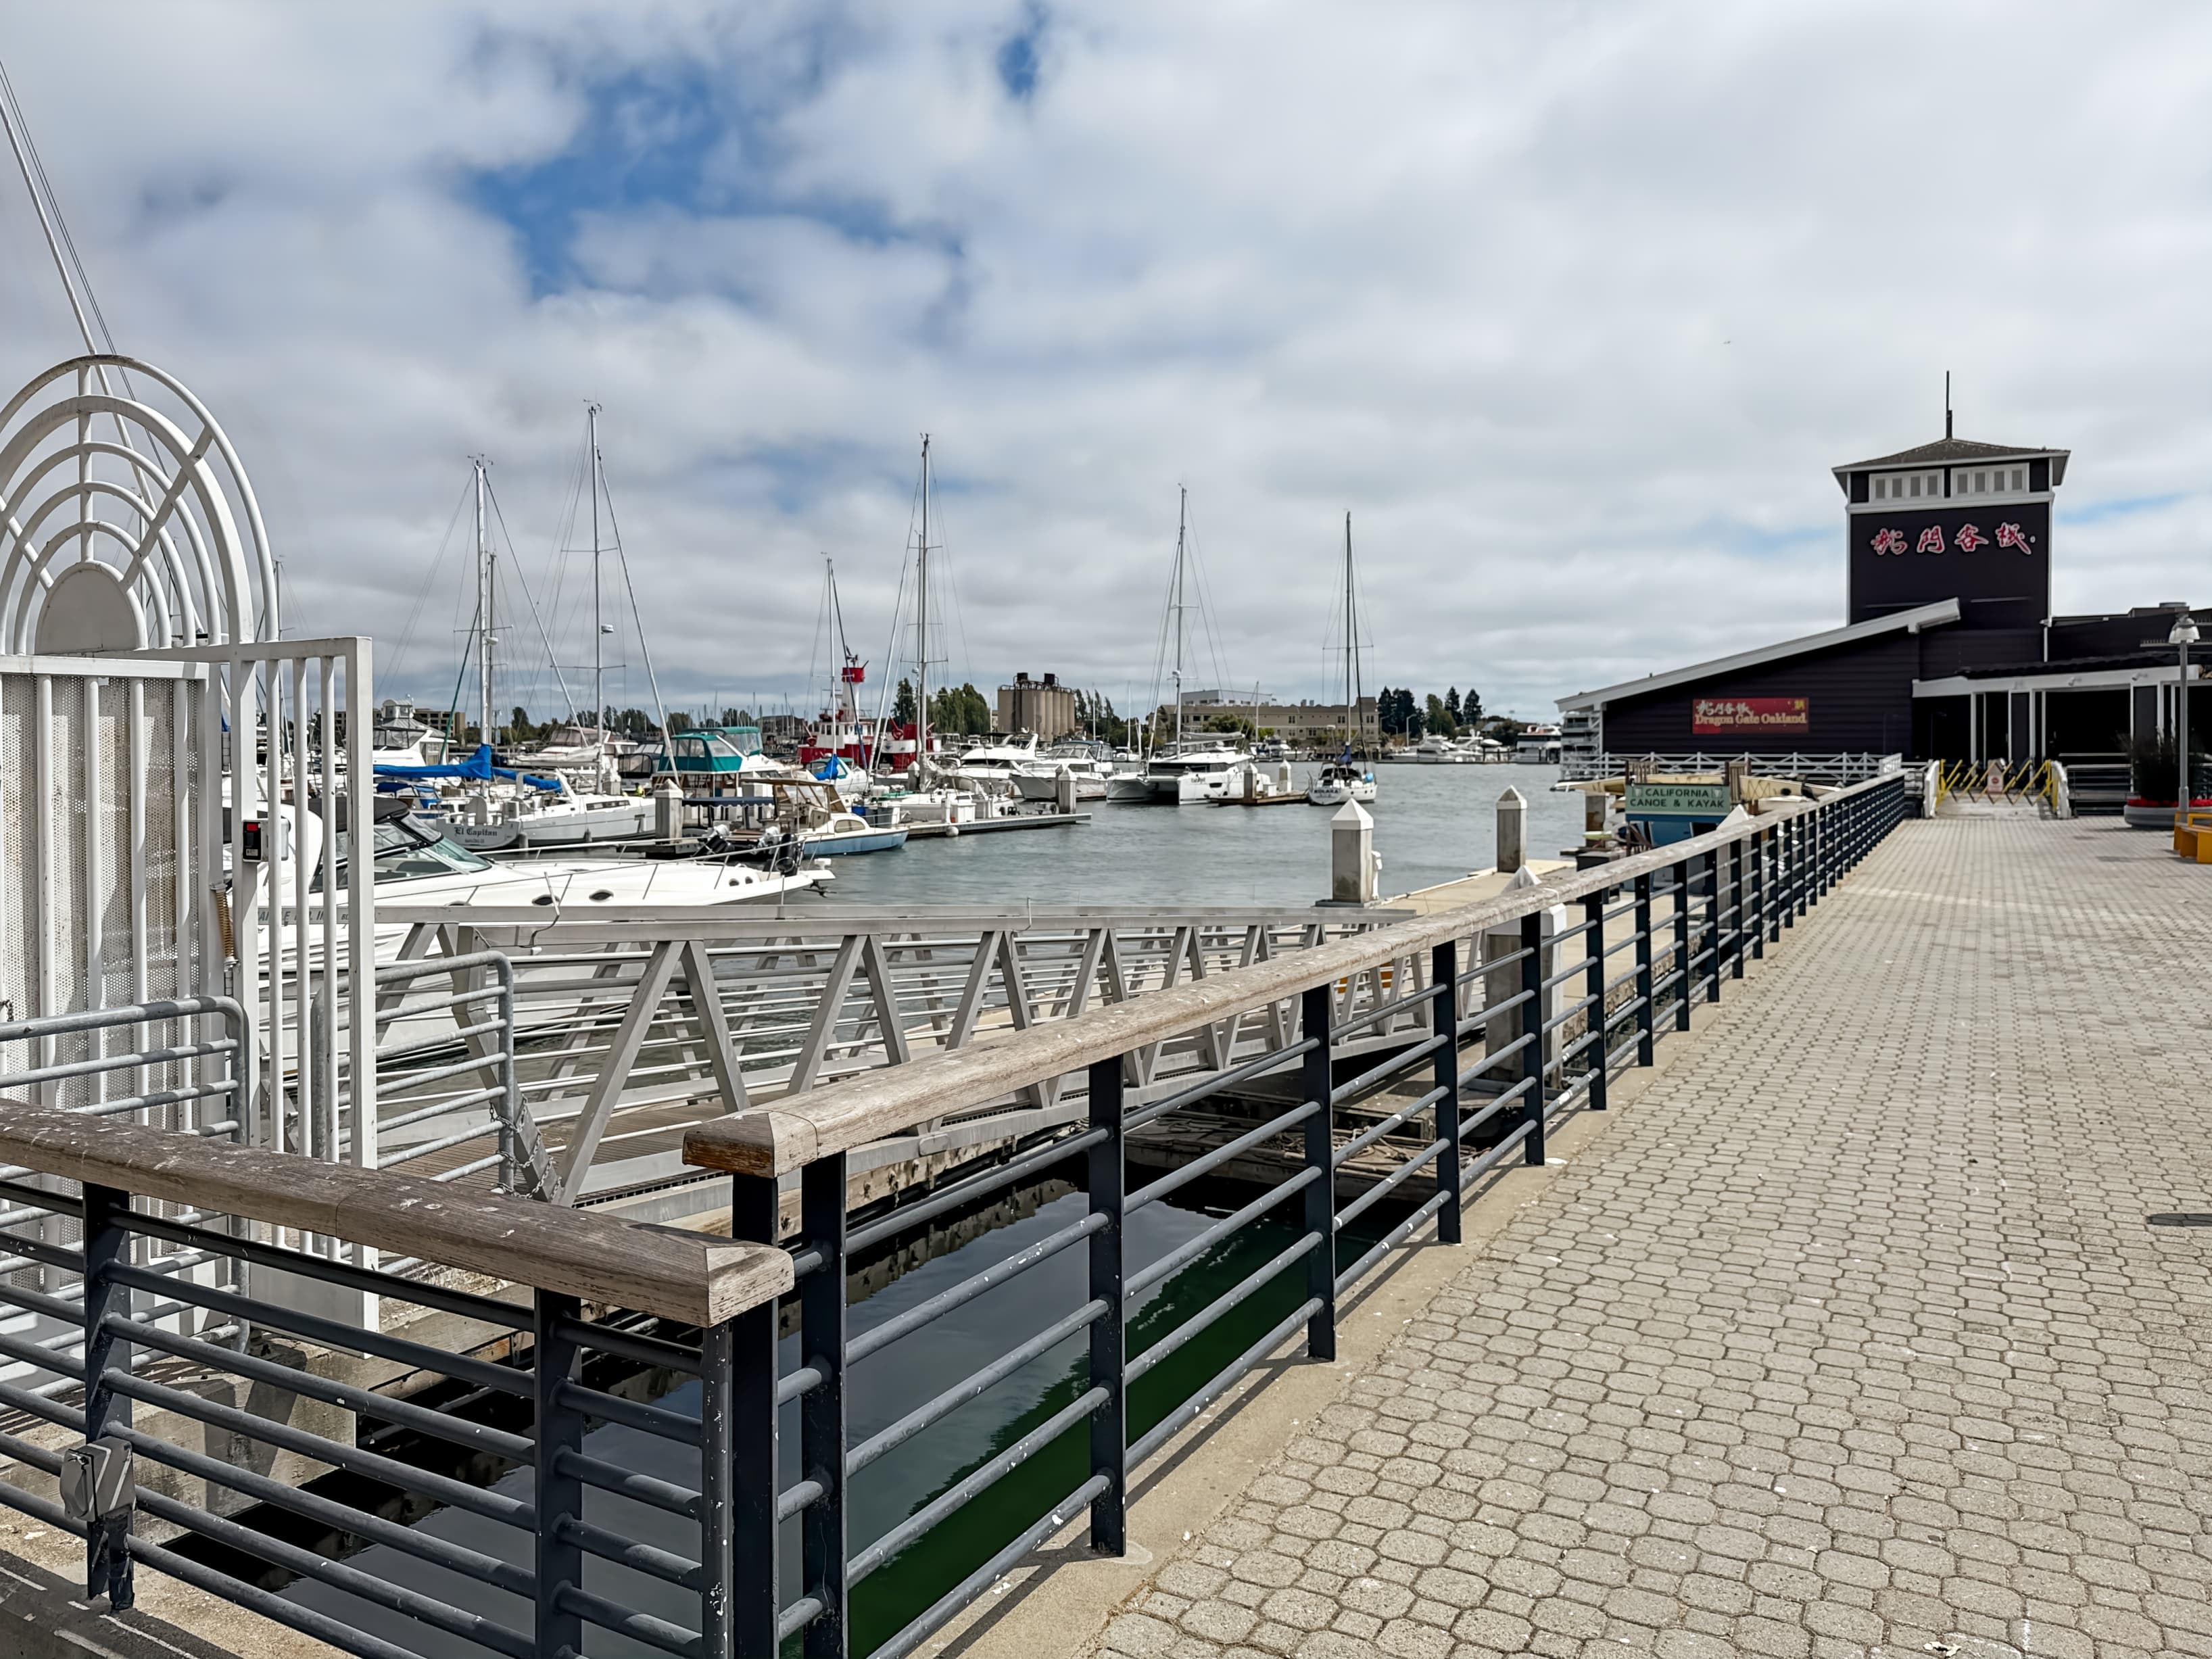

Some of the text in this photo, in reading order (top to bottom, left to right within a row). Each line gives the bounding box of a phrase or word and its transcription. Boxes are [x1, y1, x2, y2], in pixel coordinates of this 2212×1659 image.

[1695, 714, 1733, 726] Dragon
[1735, 714, 1760, 724] Gate
[1645, 788, 1708, 798] CALIFORNIA
[1630, 798, 1724, 808] CANOE & KAYAK
[454, 827, 498, 837] El Capitan
